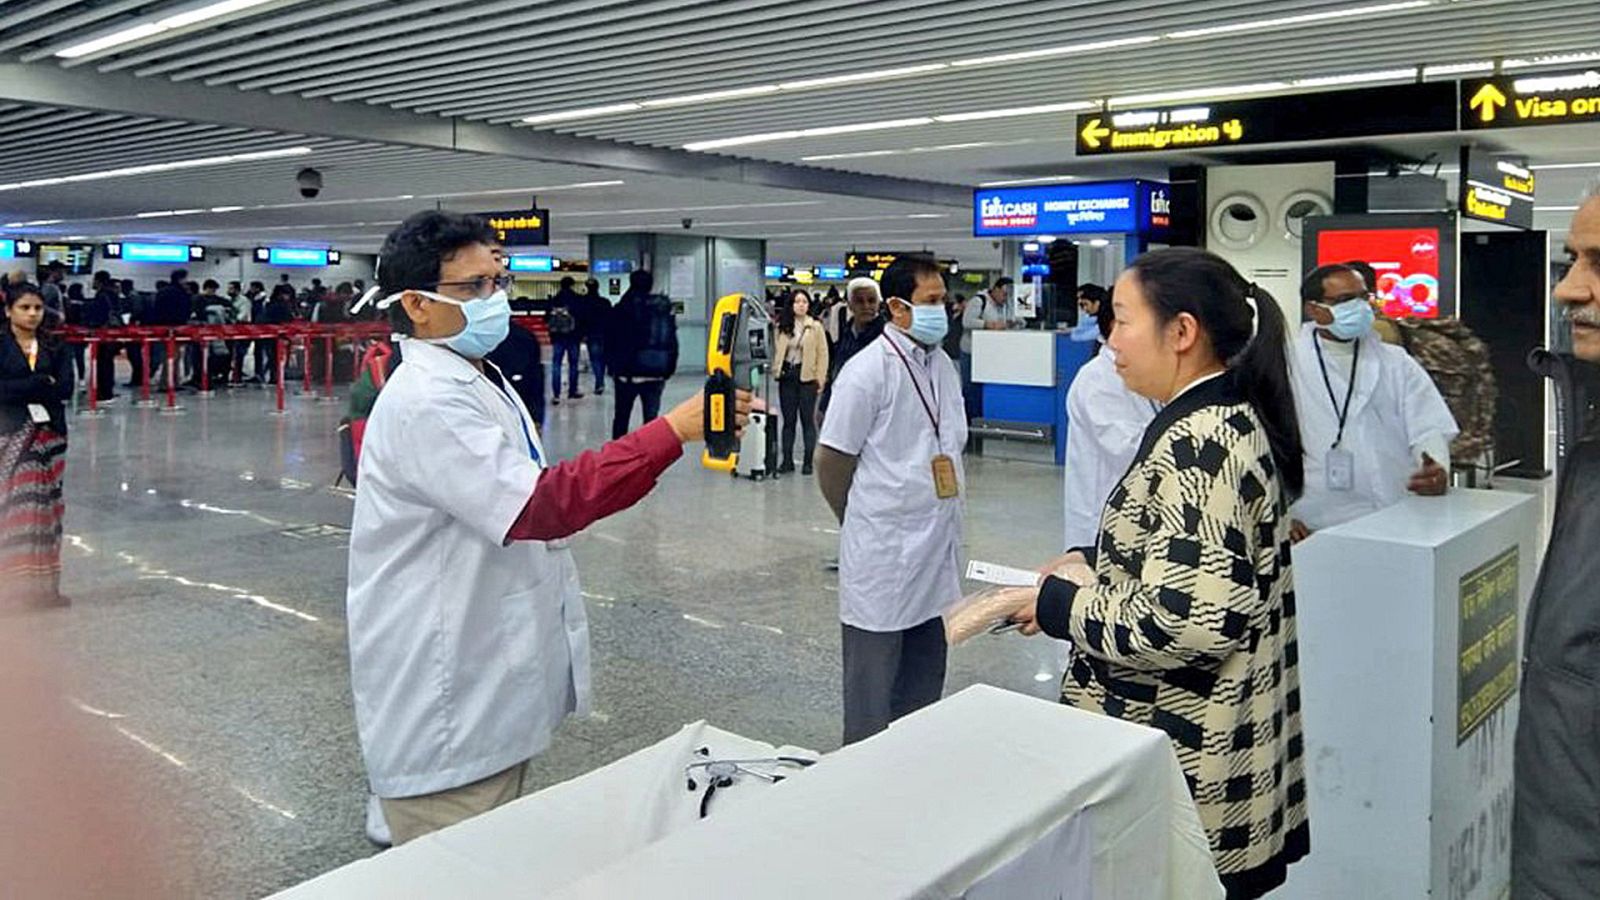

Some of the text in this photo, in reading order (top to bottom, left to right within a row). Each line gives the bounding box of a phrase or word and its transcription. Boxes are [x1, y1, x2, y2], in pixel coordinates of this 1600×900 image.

[1514, 96, 1600, 119] Visa on
[1111, 124, 1219, 148] Immigration
[1044, 198, 1130, 212] MONEY EXCHANGE
